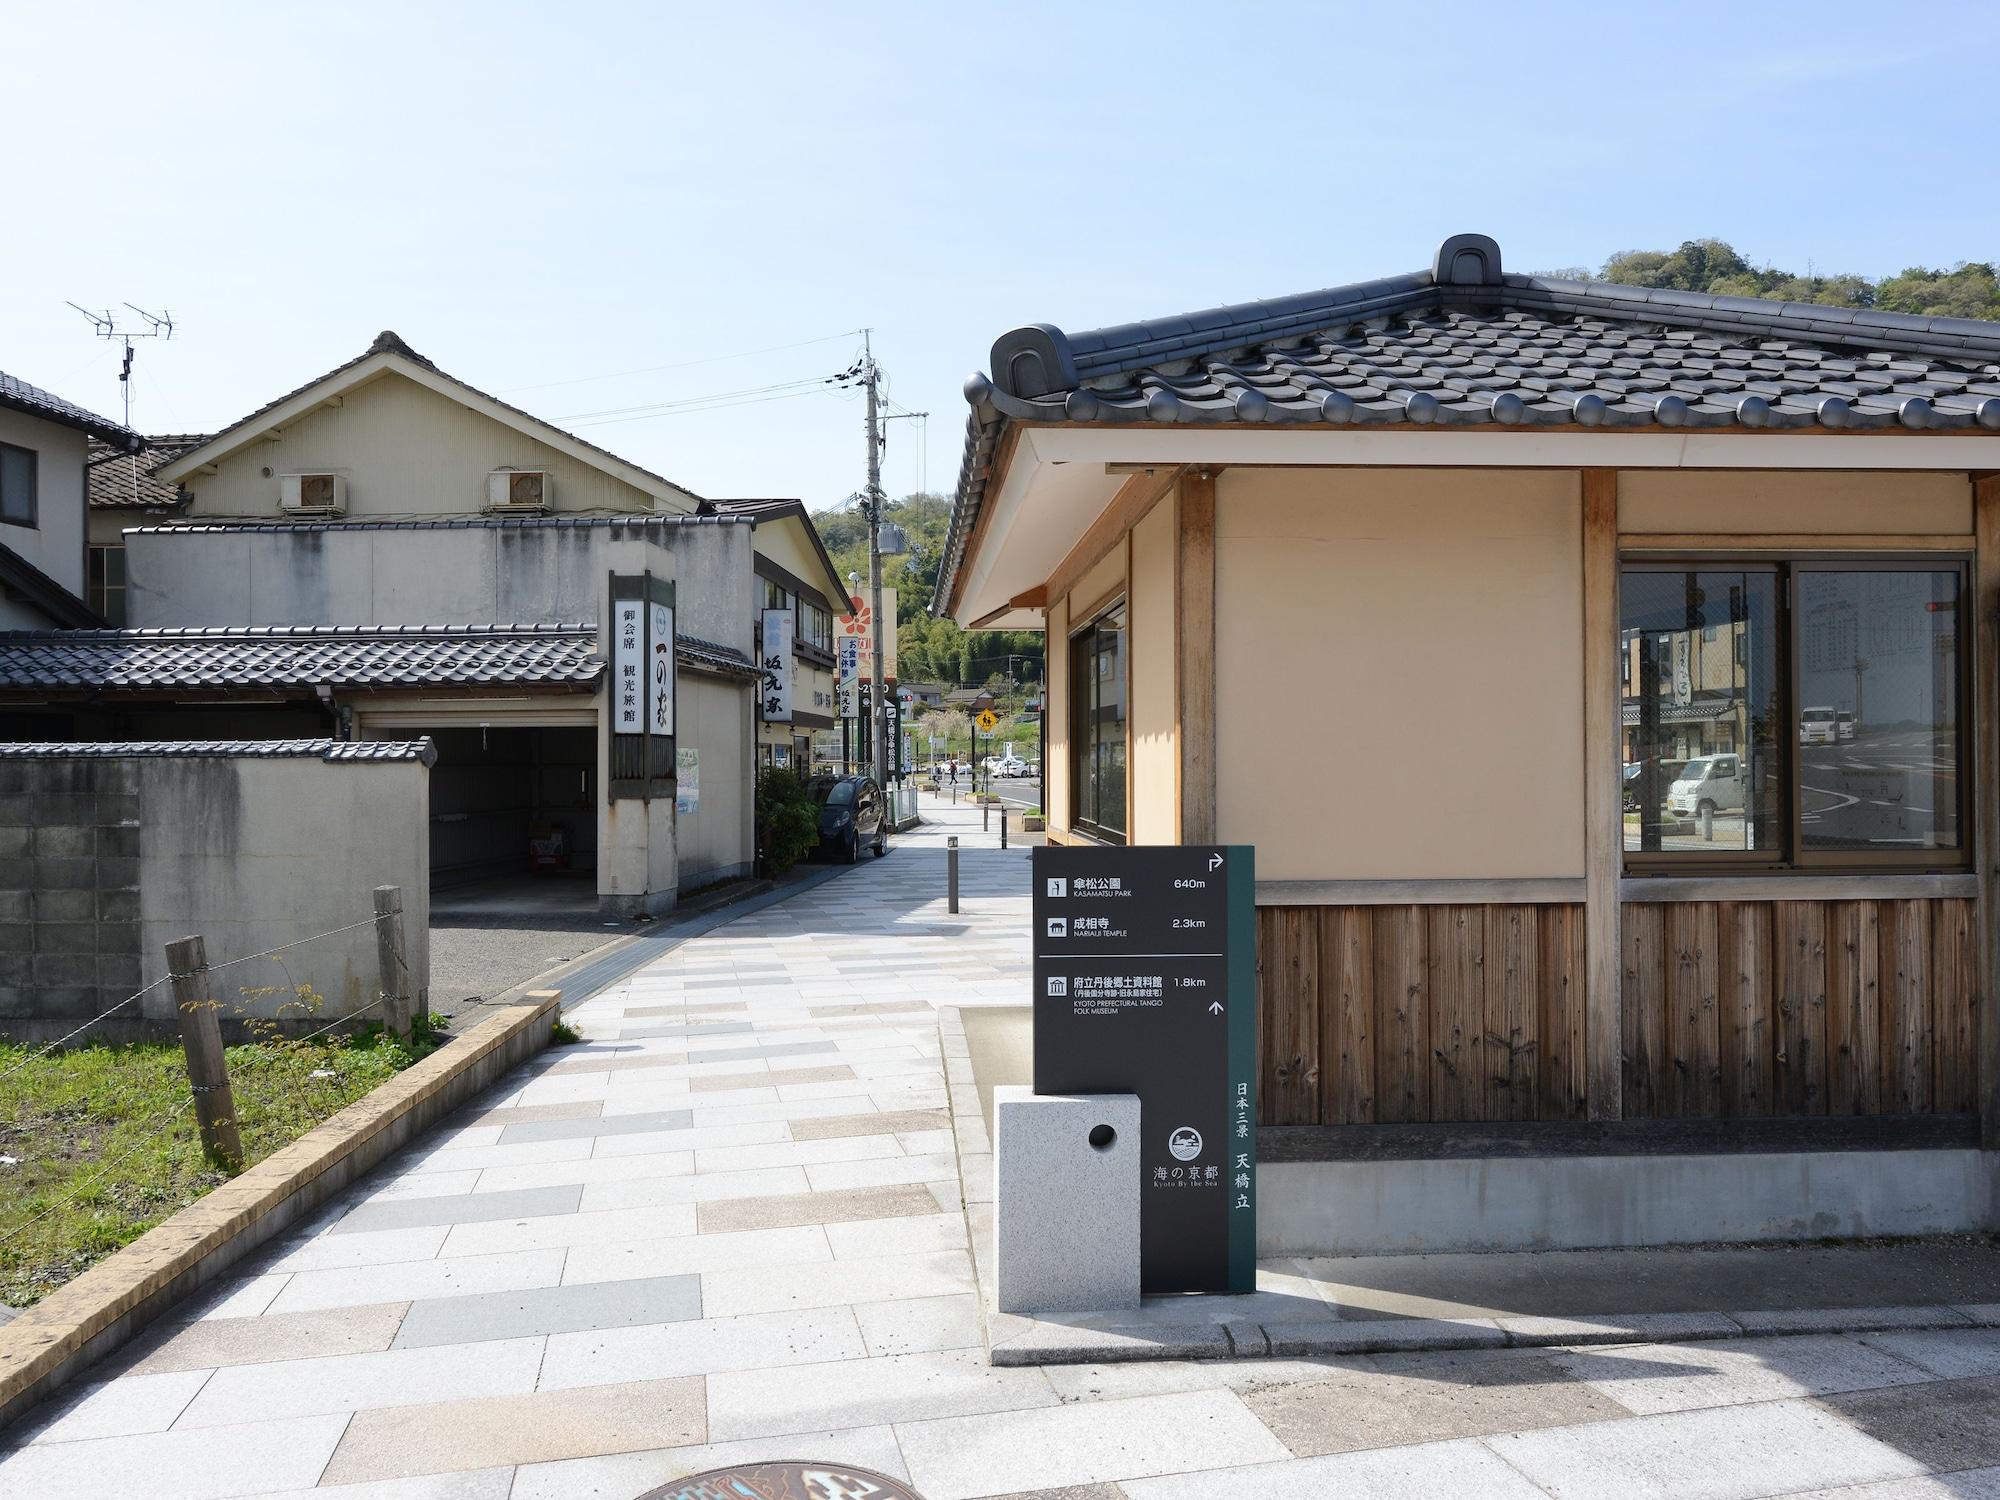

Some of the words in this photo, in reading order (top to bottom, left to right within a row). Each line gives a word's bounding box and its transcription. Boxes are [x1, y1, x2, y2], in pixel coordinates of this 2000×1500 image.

[623, 609, 636, 650] 御会席
[849, 639, 857, 668] お食事
[841, 649, 849, 678] ご休憩
[623, 664, 636, 722] 観光旅館
[1073, 877, 1121, 890] 傘松公園
[1174, 879, 1206, 889] 640m
[1073, 917, 1110, 930] 成相寺
[1172, 919, 1206, 928] 2.3km
[1073, 976, 1163, 989] 府立丹後郷土資料館
[1174, 978, 1206, 987] 1.8km
[1236, 1082, 1249, 1138] 日本三景
[1153, 1165, 1218, 1180] 海の京都
[1234, 1153, 1250, 1209] 天橋立
